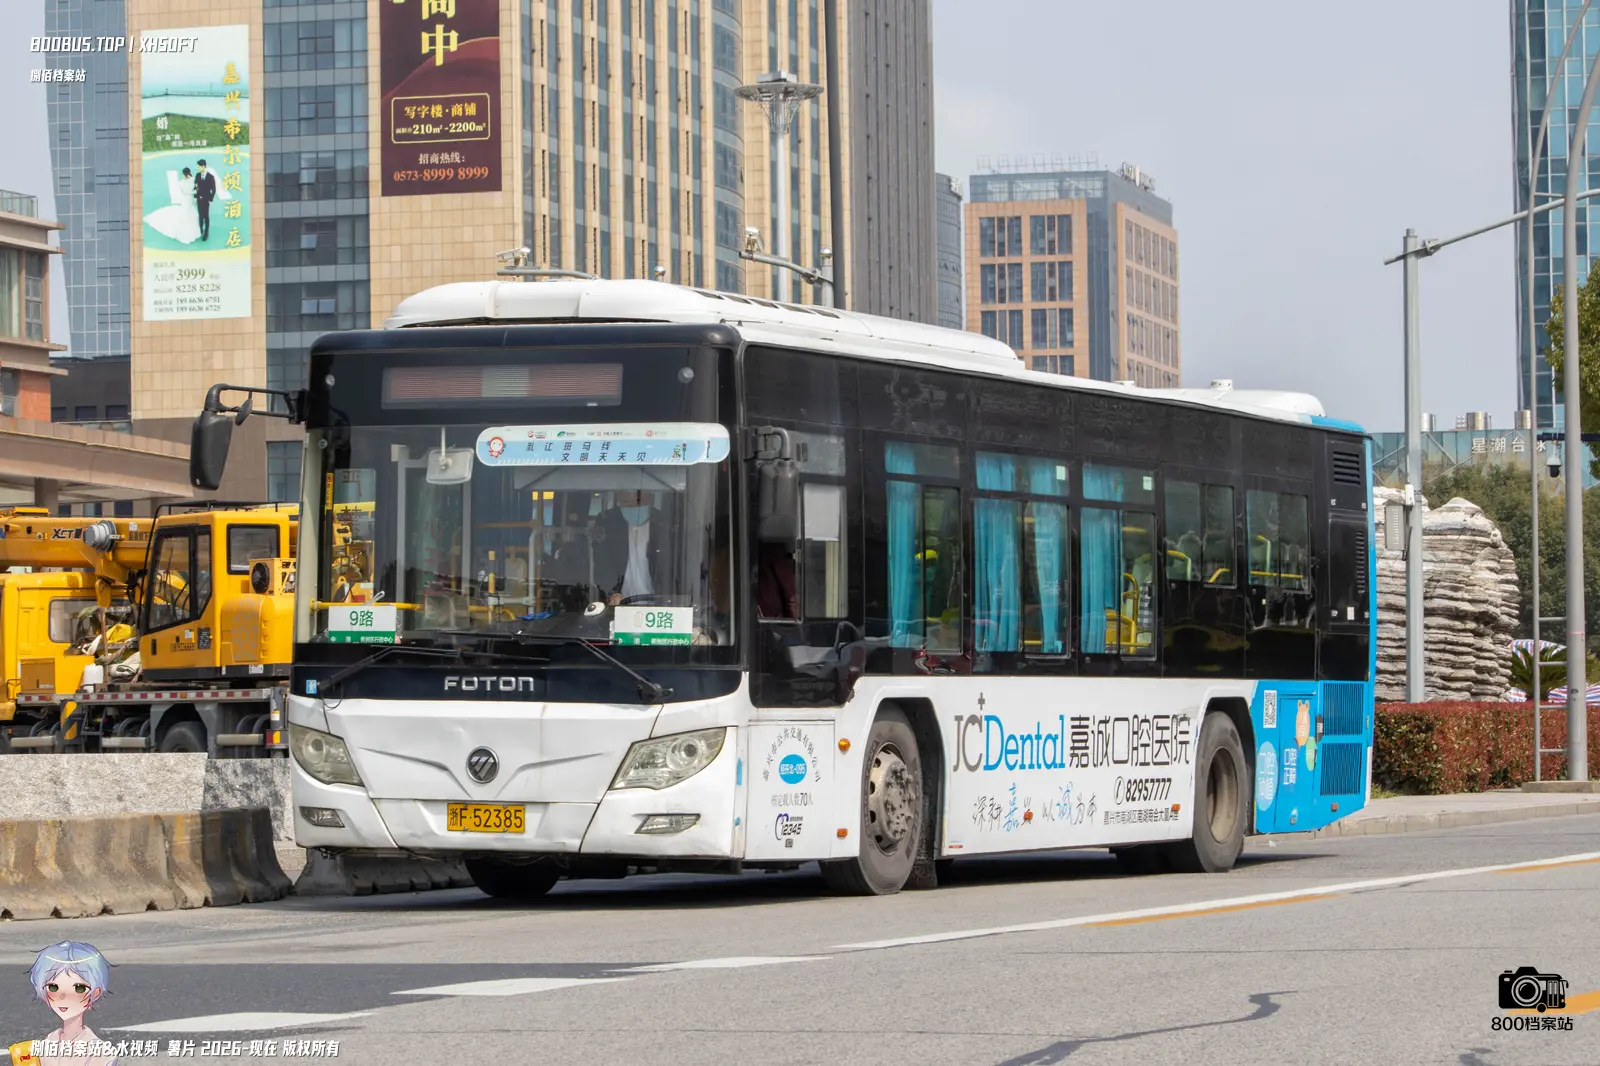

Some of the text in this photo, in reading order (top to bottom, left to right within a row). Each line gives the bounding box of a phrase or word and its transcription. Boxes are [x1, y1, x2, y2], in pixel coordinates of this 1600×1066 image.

[393, 166, 489, 182] 0573-8999 8999
[176, 268, 206, 281] 3999
[176, 284, 198, 293] 8228
[199, 283, 221, 292] 8228
[349, 610, 374, 627] 9路
[645, 611, 674, 629] 9路
[444, 676, 535, 692] FOTON
[1069, 713, 1191, 769] 嘉诚口腔医院
[1125, 777, 1173, 802] 82957777
[781, 824, 802, 836] 12345
